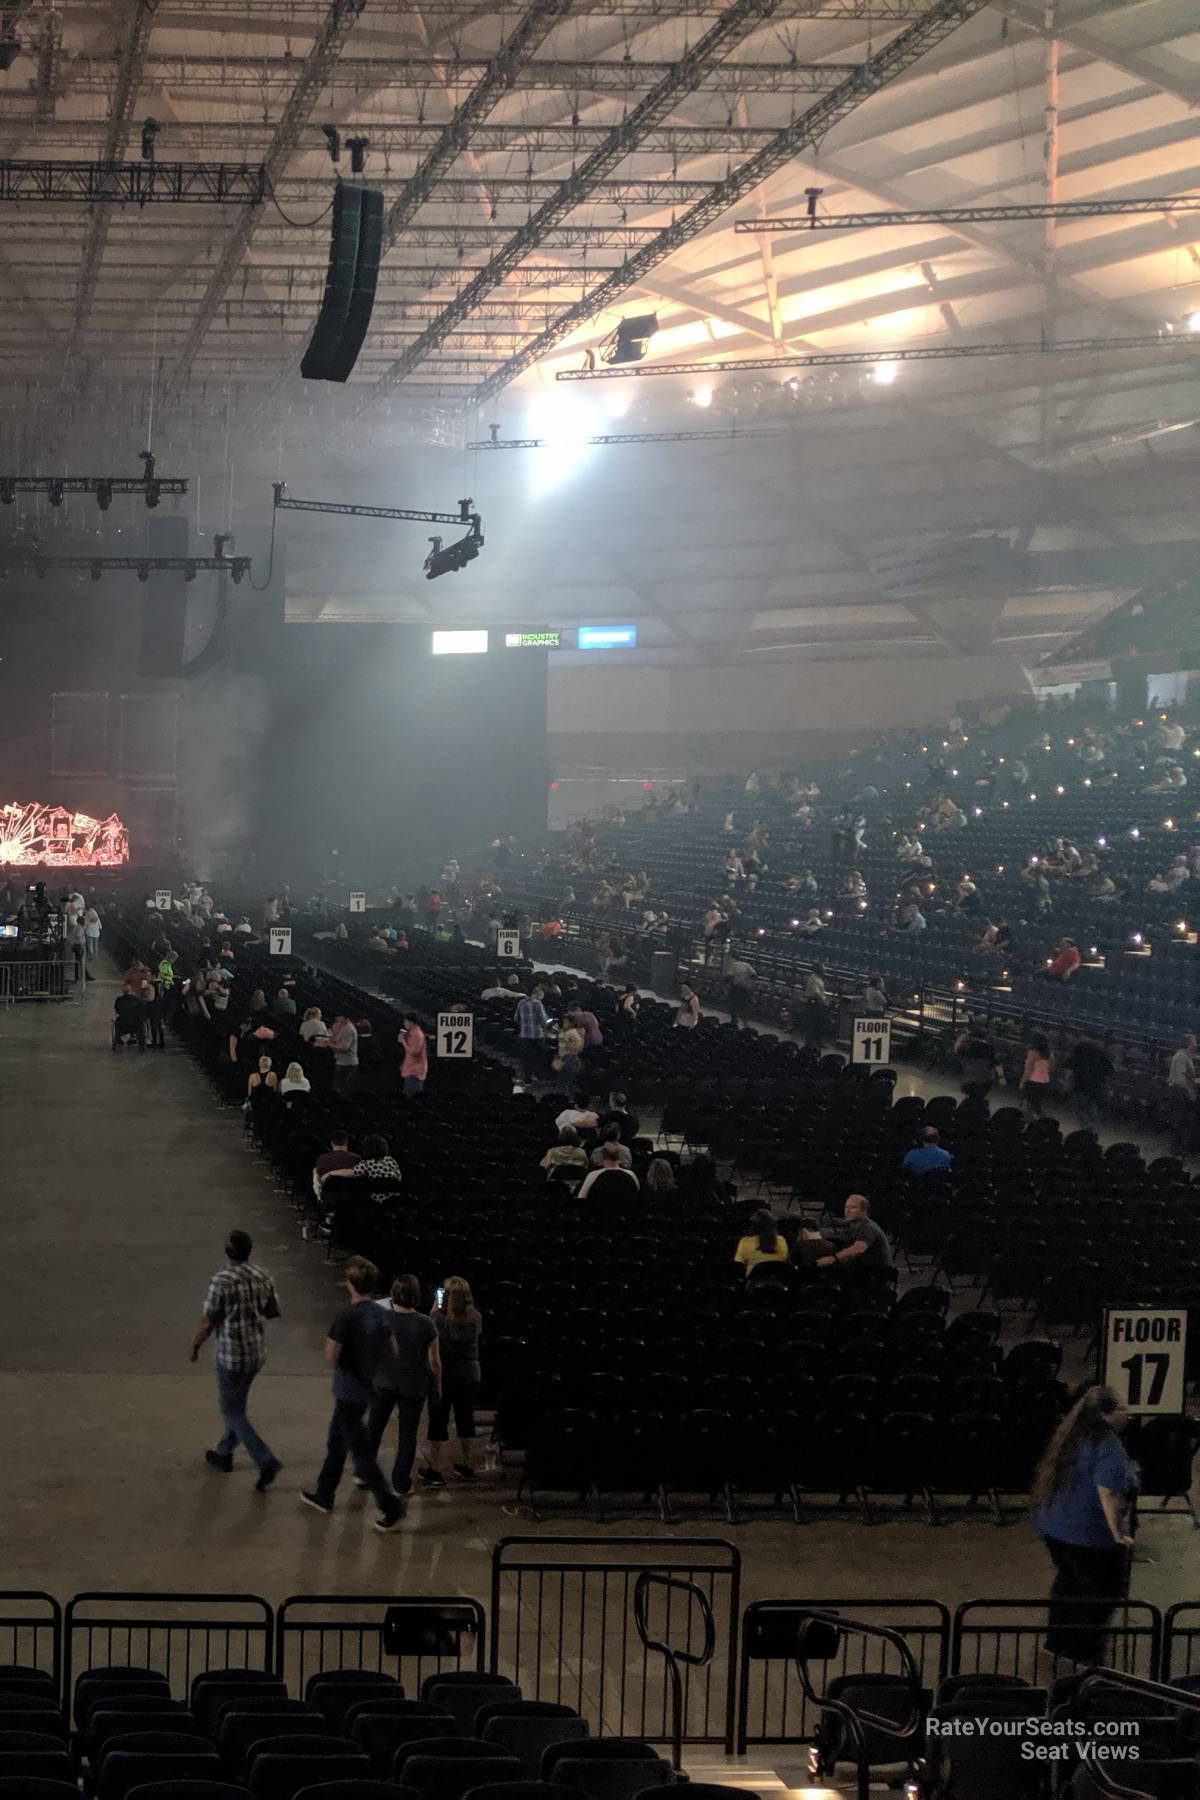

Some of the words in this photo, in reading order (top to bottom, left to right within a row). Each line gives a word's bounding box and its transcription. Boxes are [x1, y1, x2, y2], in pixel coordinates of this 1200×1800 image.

[159, 898, 167, 908] 2
[356, 900, 360, 911] 1
[271, 929, 291, 937] FLOOR
[277, 938, 285, 953] 7
[504, 940, 513, 955] 6
[440, 1016, 471, 1027] FLOOR
[857, 1021, 888, 1033] FLOOR
[443, 1030, 467, 1054] 12
[861, 1037, 882, 1060] 11
[1112, 1317, 1181, 1342] FLOOR
[1121, 1353, 1170, 1405] 17
